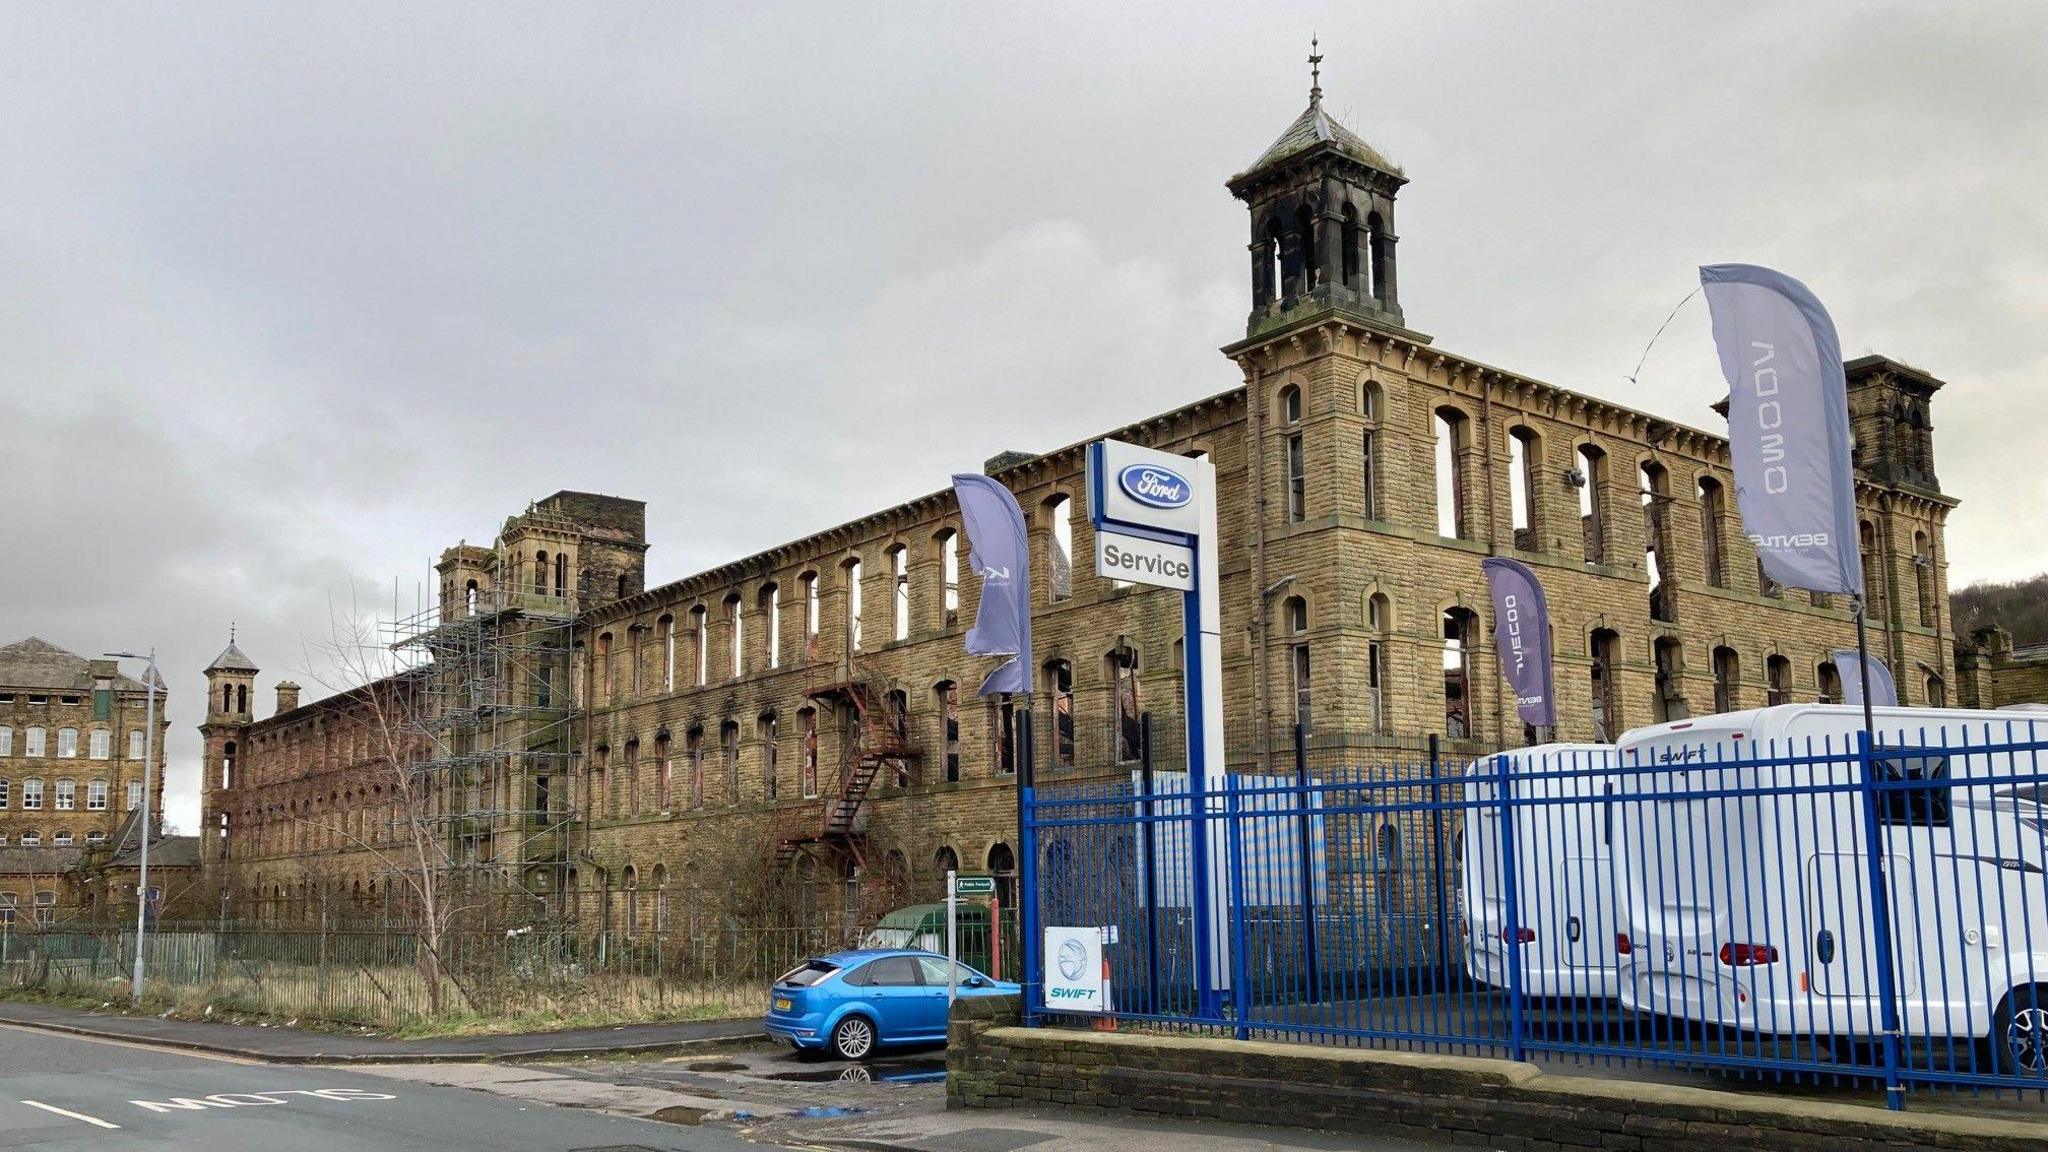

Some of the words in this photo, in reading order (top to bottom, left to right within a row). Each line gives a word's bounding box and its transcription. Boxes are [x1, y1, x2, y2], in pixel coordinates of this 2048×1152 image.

[1138, 470, 1180, 501] Ford
[1104, 544, 1190, 579] Service
[1051, 987, 1096, 999] SWIFT
[128, 1087, 397, 1113] SLOW
